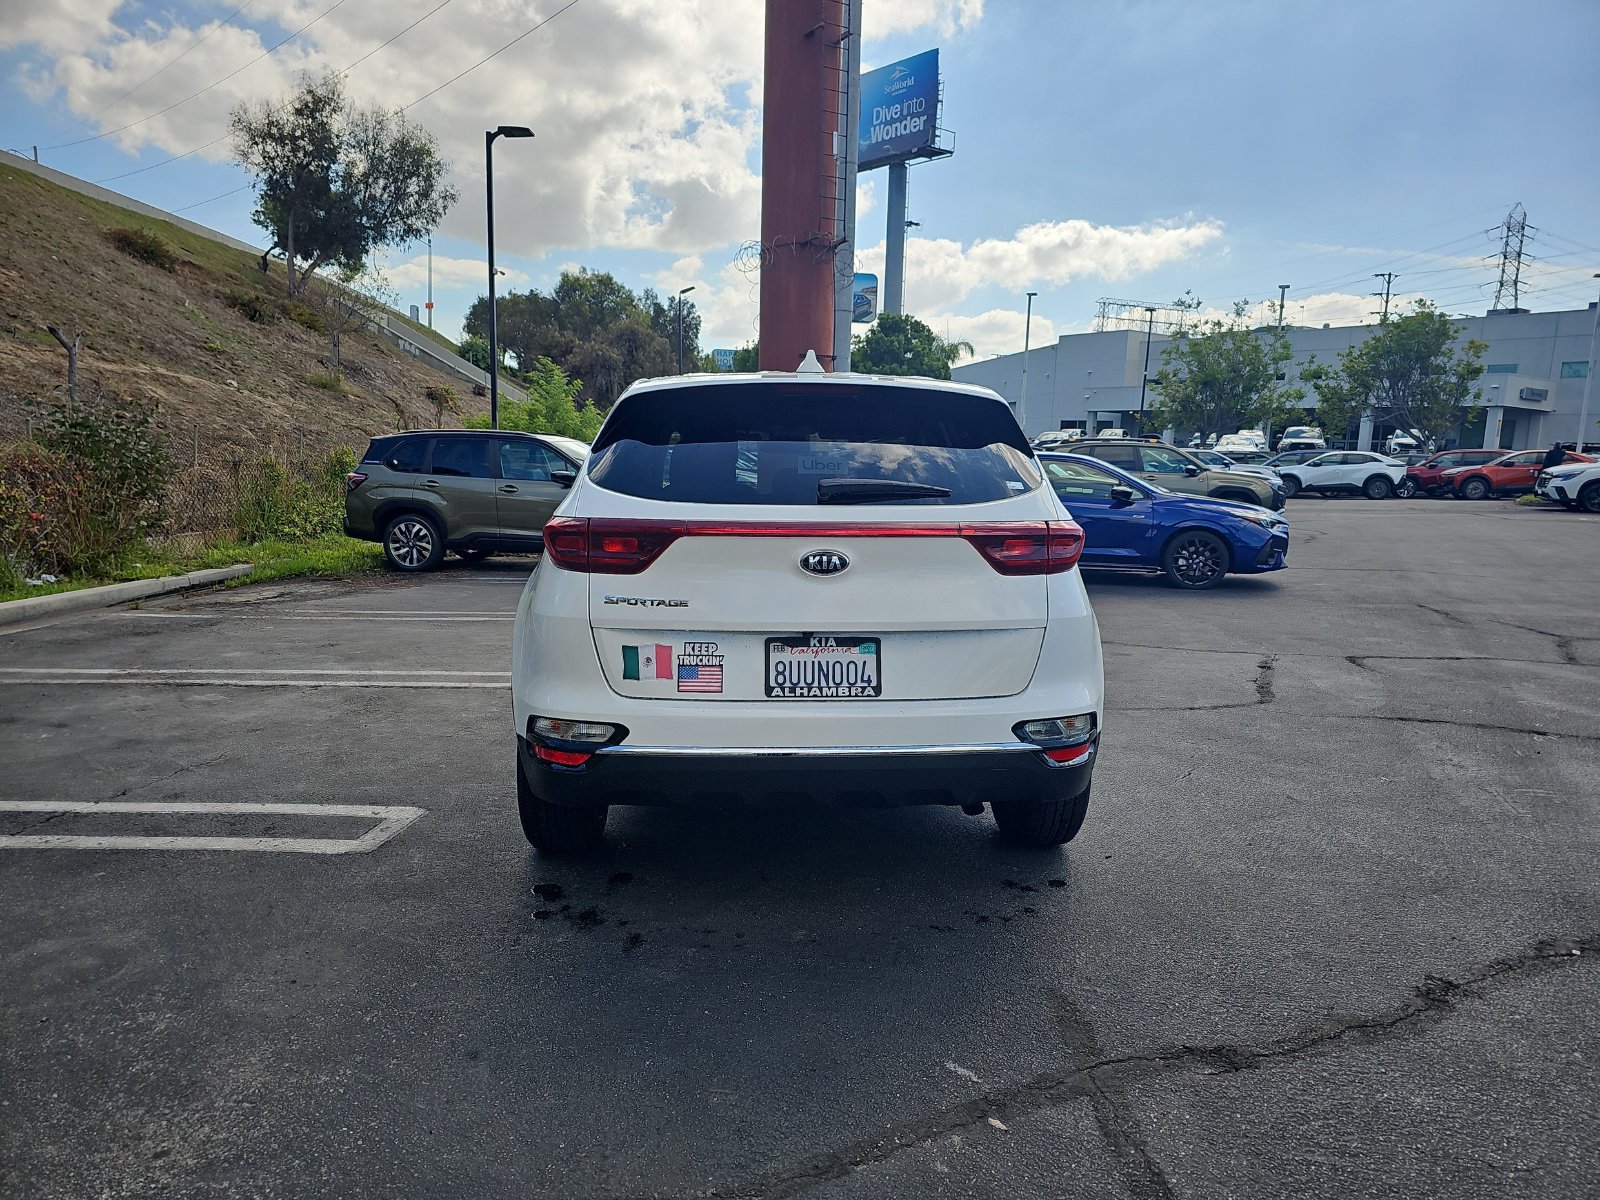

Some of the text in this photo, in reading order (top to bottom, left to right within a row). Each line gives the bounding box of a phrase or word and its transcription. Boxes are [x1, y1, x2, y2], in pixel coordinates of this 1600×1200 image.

[884, 76, 915, 94] SeaWorld
[873, 97, 925, 125] Dive into
[870, 115, 927, 143] Wonder
[802, 459, 842, 471] Uber
[808, 555, 841, 570] KIA
[604, 594, 689, 607] SPORTAGE
[810, 637, 836, 647] KIA
[685, 643, 717, 655] KEEP
[678, 655, 724, 665] TRUCKIN'
[774, 660, 873, 686] 8UUN004
[771, 687, 876, 697] ALHAMBRA
